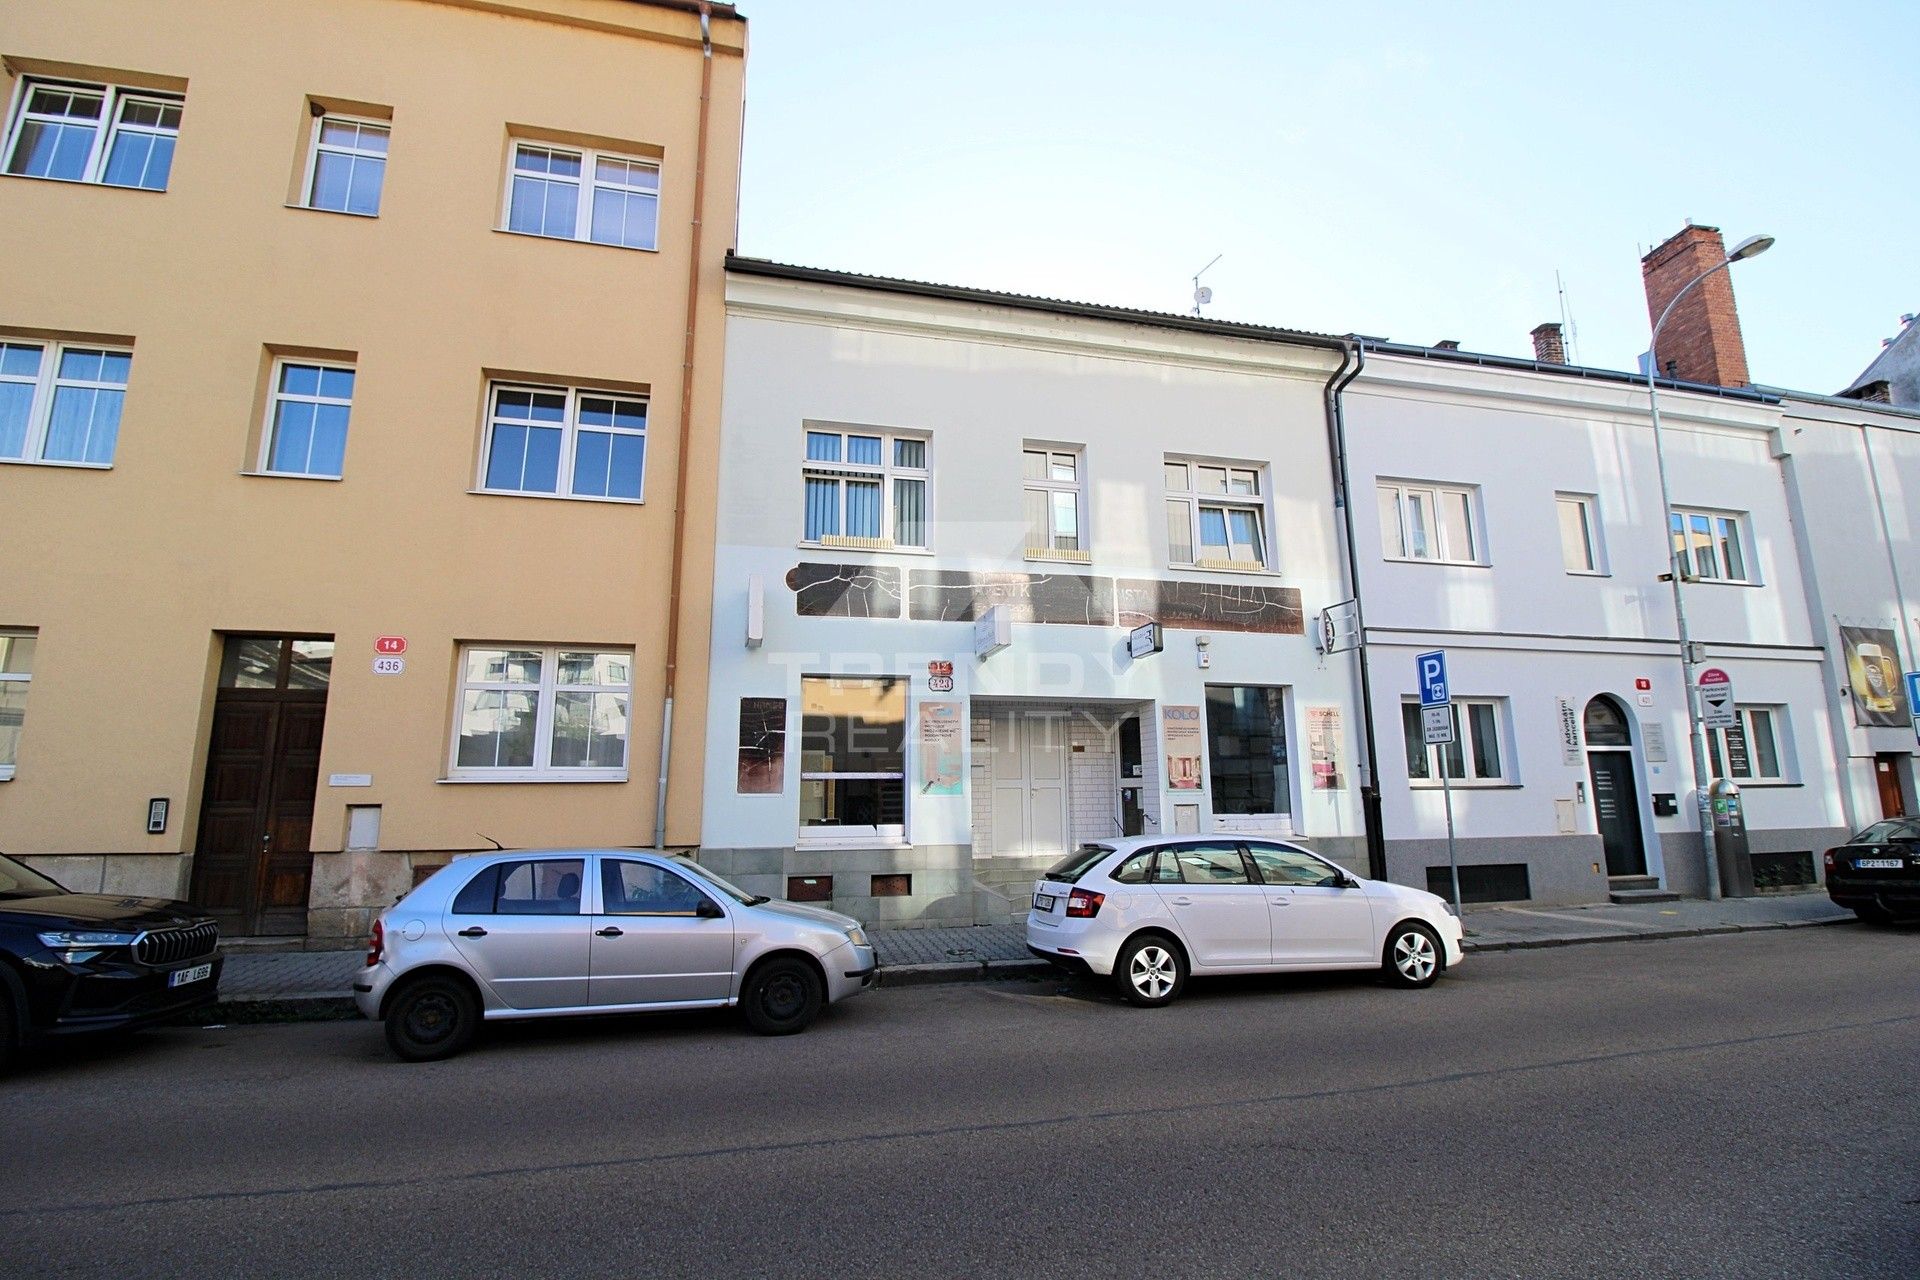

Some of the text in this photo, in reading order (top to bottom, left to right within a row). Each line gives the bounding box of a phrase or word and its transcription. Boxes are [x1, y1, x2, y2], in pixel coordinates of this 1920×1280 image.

[384, 640, 398, 650] 14
[378, 661, 399, 671] 436
[1423, 659, 1441, 690] P
